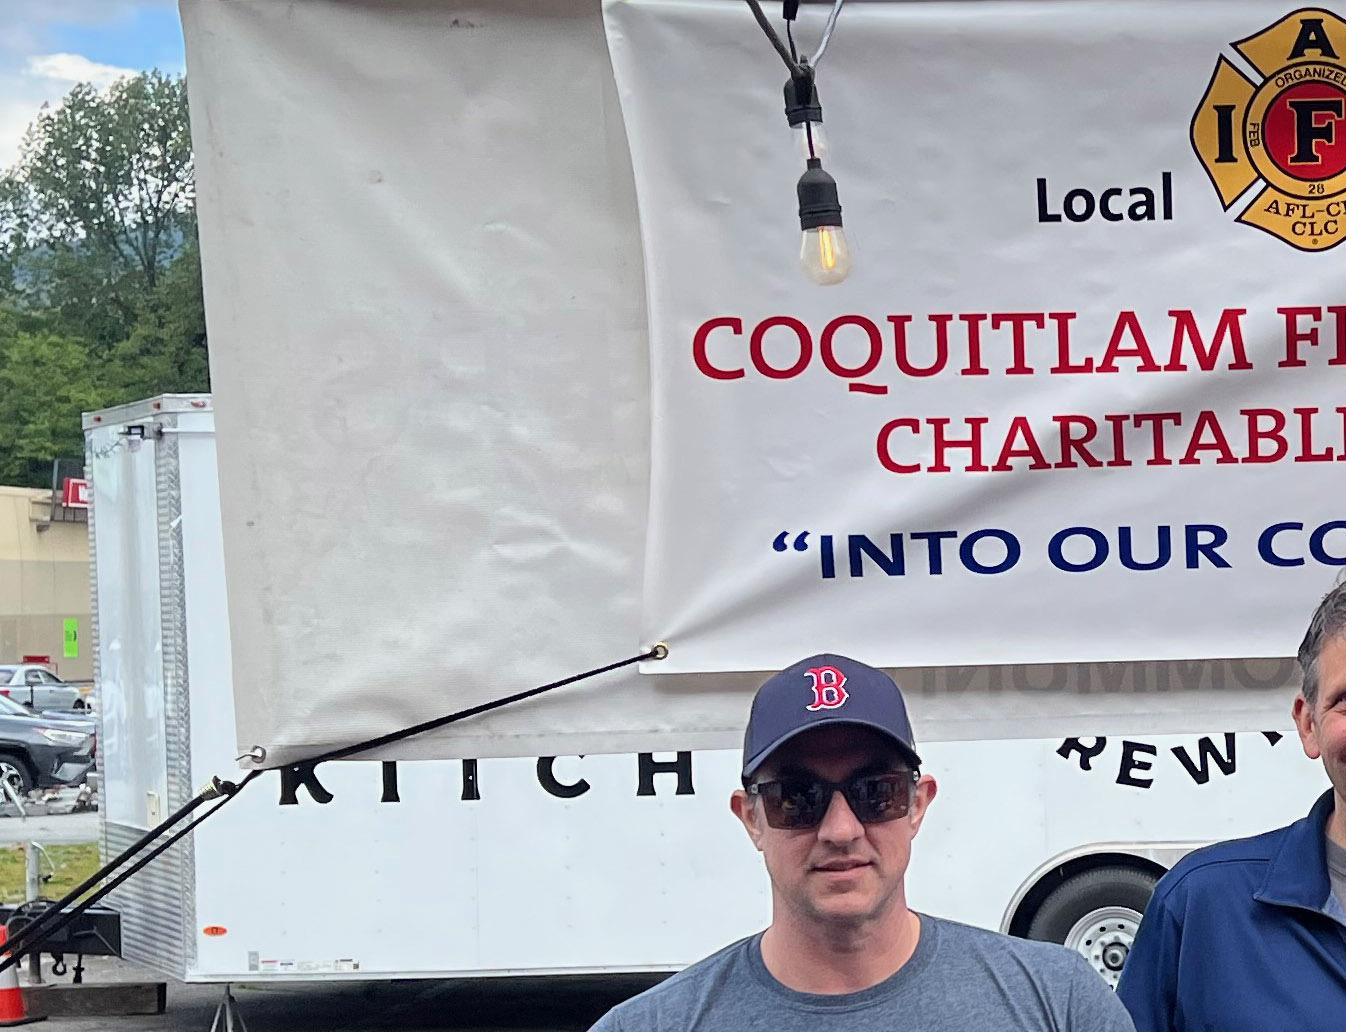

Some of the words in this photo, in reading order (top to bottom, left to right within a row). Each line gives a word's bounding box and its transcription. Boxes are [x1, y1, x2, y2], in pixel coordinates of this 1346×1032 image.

[1286, 18, 1340, 60] A
[1213, 104, 1238, 163] I
[1248, 122, 1260, 148] FEB
[1286, 98, 1345, 165] F
[1036, 172, 1173, 223] Local
[1308, 183, 1325, 195] 28
[1291, 219, 1339, 236] CLC
[692, 307, 1253, 395] COQUITLAM
[772, 527, 1021, 580] “INTO
[1048, 524, 1230, 572] OUR
[803, 665, 850, 711] B
